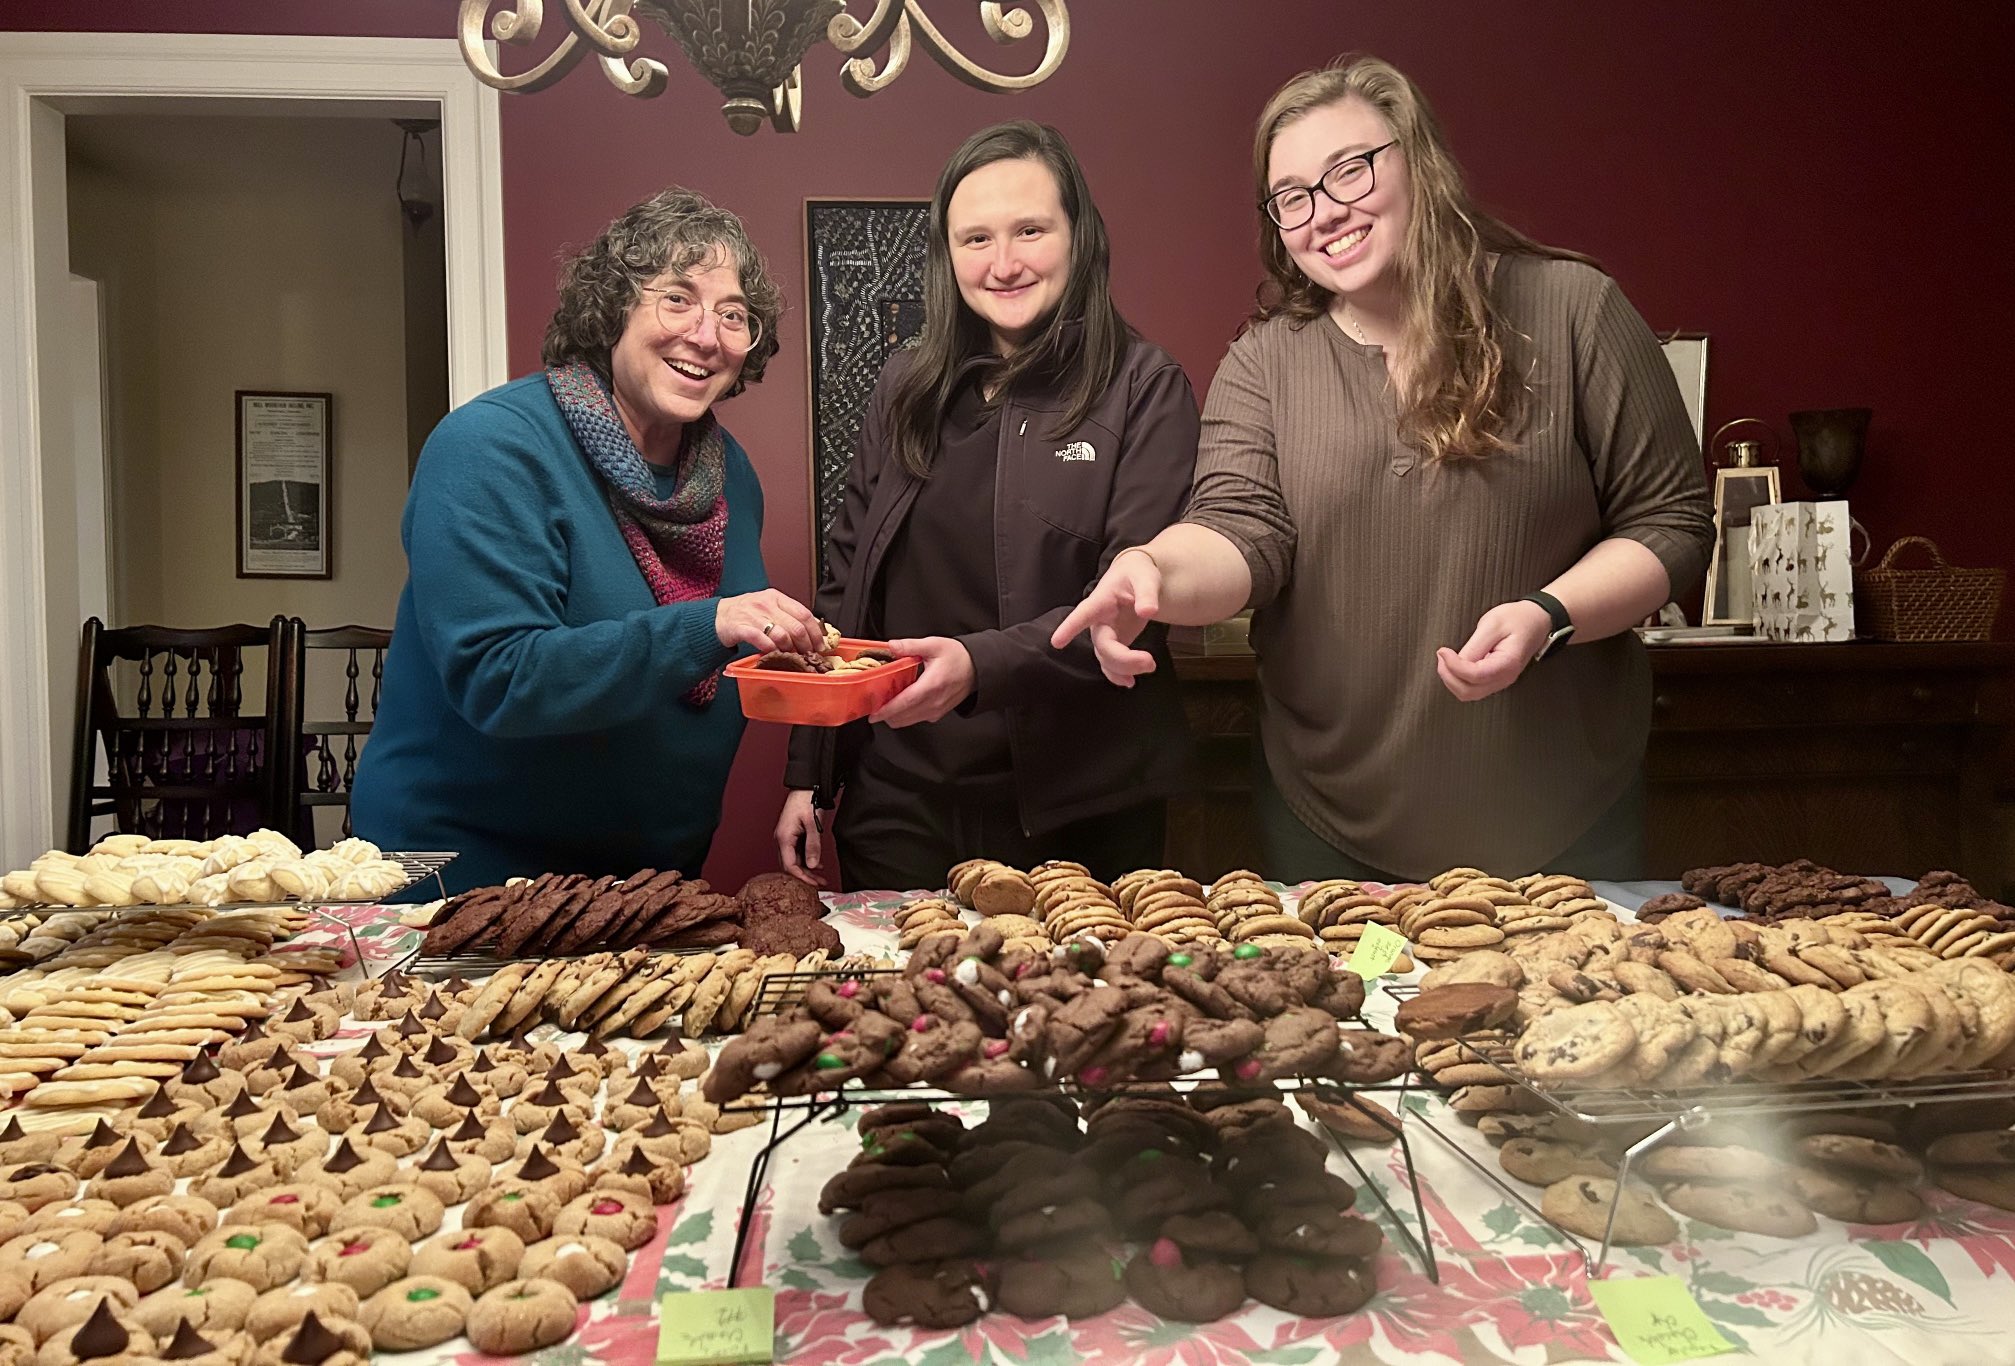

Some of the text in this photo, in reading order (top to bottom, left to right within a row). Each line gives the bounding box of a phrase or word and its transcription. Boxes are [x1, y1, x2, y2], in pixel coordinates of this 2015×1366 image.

[1066, 441, 1082, 450] THE
[1055, 447, 1082, 457] NORTH
[1062, 453, 1082, 462] FACE
